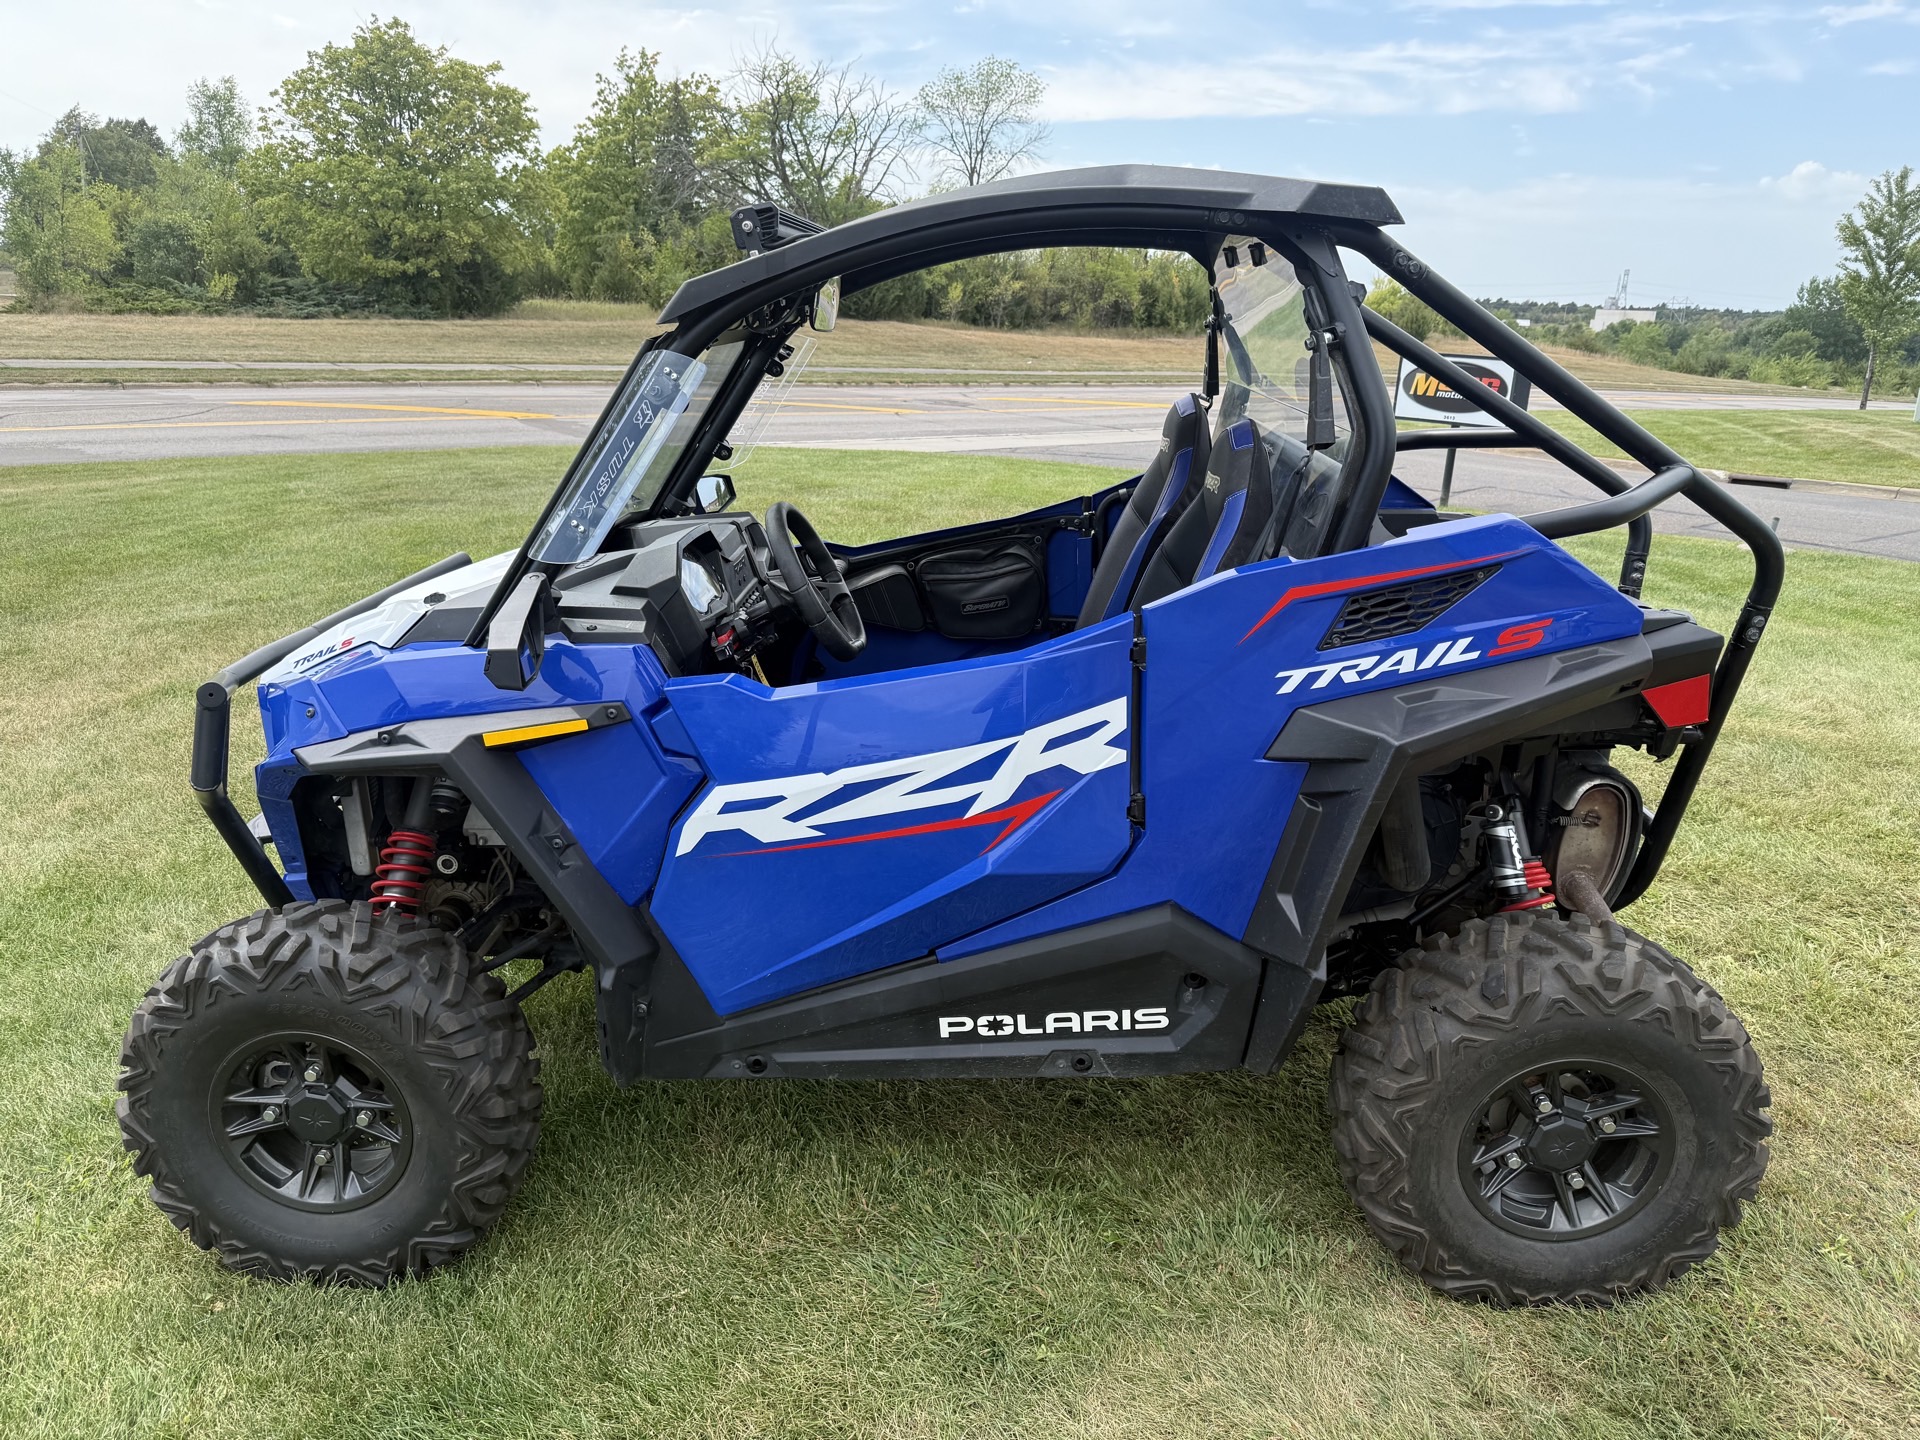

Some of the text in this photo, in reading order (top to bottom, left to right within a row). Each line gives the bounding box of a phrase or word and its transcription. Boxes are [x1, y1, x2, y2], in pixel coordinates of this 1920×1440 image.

[582, 436, 635, 519] TUSK
[293, 643, 338, 669] TRAIL
[339, 636, 356, 650] S
[1275, 618, 1553, 695] TRAIL S
[675, 696, 1127, 857] RZR
[938, 1007, 1170, 1038] POLARIS
